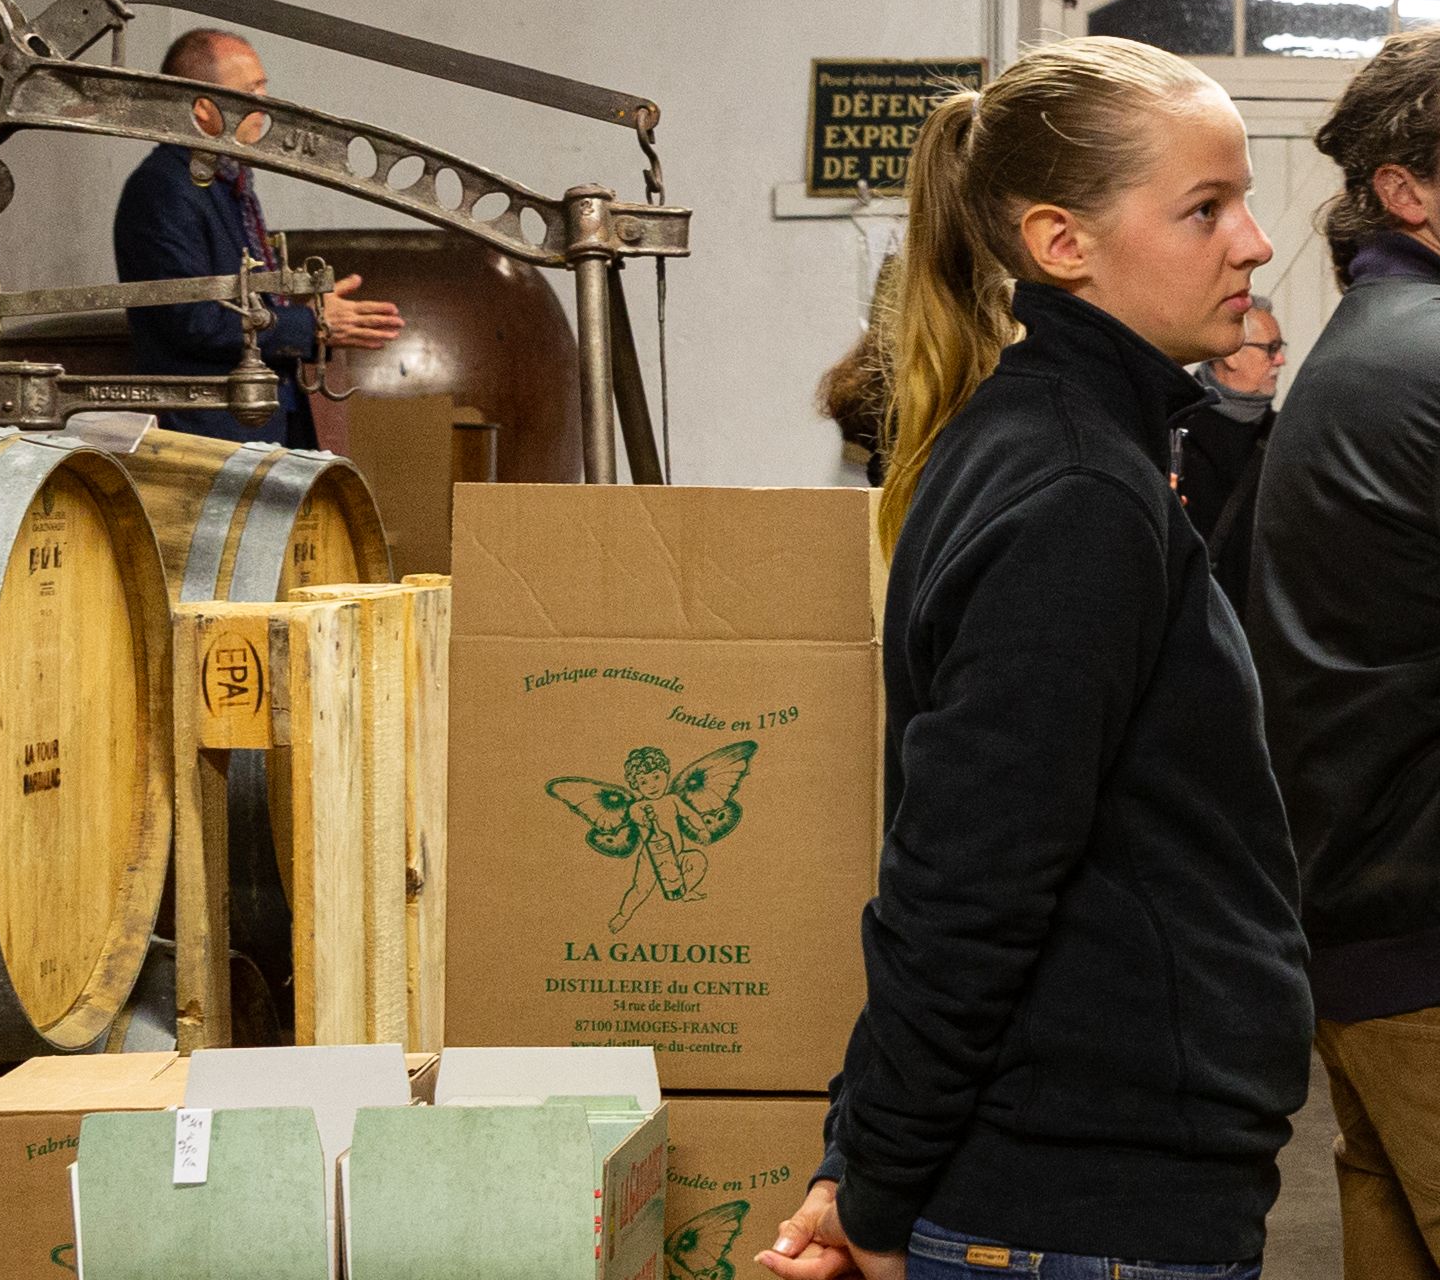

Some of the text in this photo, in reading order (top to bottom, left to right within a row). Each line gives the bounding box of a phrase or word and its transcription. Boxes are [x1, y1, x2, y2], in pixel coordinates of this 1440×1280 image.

[822, 155, 860, 180] DE
[522, 663, 685, 694] Fabrique artisanale
[667, 705, 800, 733] fondée en 1789
[564, 941, 751, 965] LA GAULOISE
[545, 978, 771, 997] DISTILLERIE du CENTRE
[613, 999, 702, 1013] 54 rue de Belfort
[574, 1019, 739, 1035] 87100 LIMOGES-FRANCE
[722, 1179, 744, 1192] en
[749, 1165, 792, 1190] 1789
